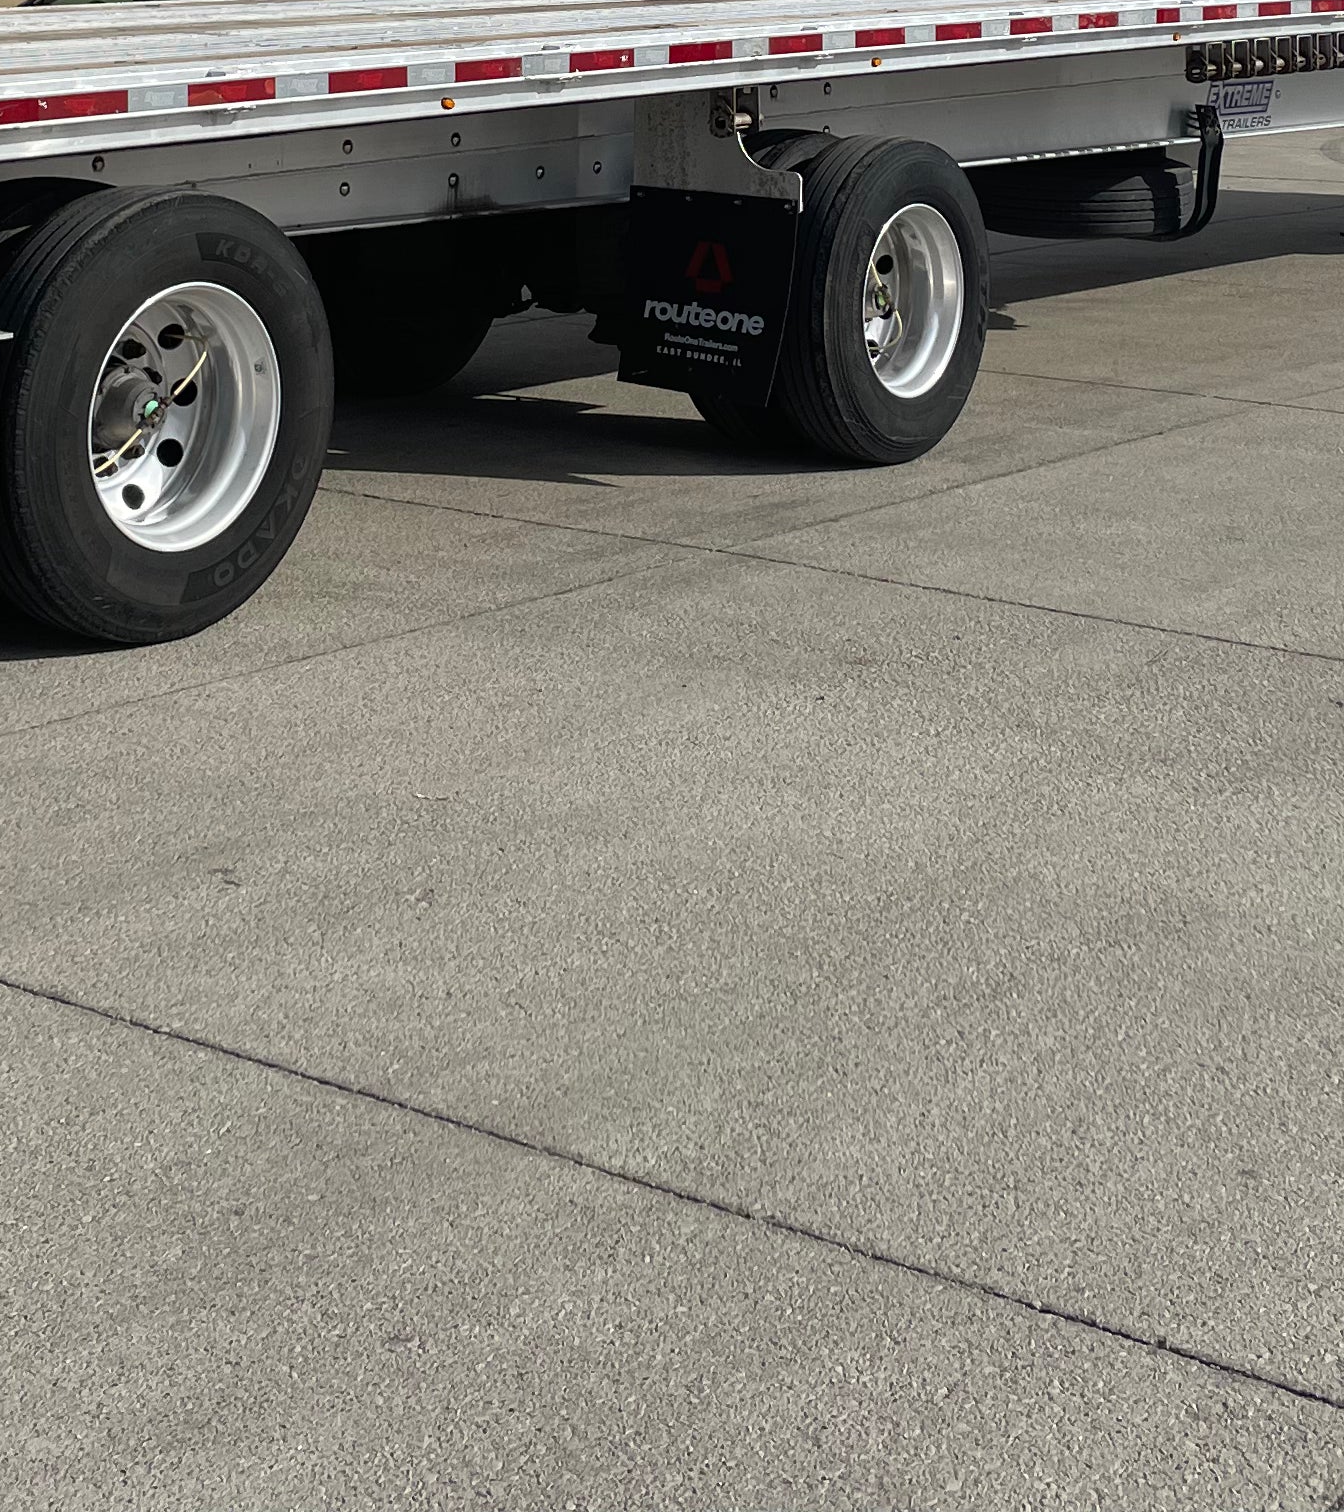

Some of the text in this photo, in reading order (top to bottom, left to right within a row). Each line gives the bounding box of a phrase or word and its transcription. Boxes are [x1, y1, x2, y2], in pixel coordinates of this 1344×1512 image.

[1208, 81, 1272, 114] EXTREME
[1222, 115, 1272, 130] TRAILERS
[643, 299, 765, 336] routeone
[656, 345, 682, 356] EAST
[732, 358, 742, 367] IL
